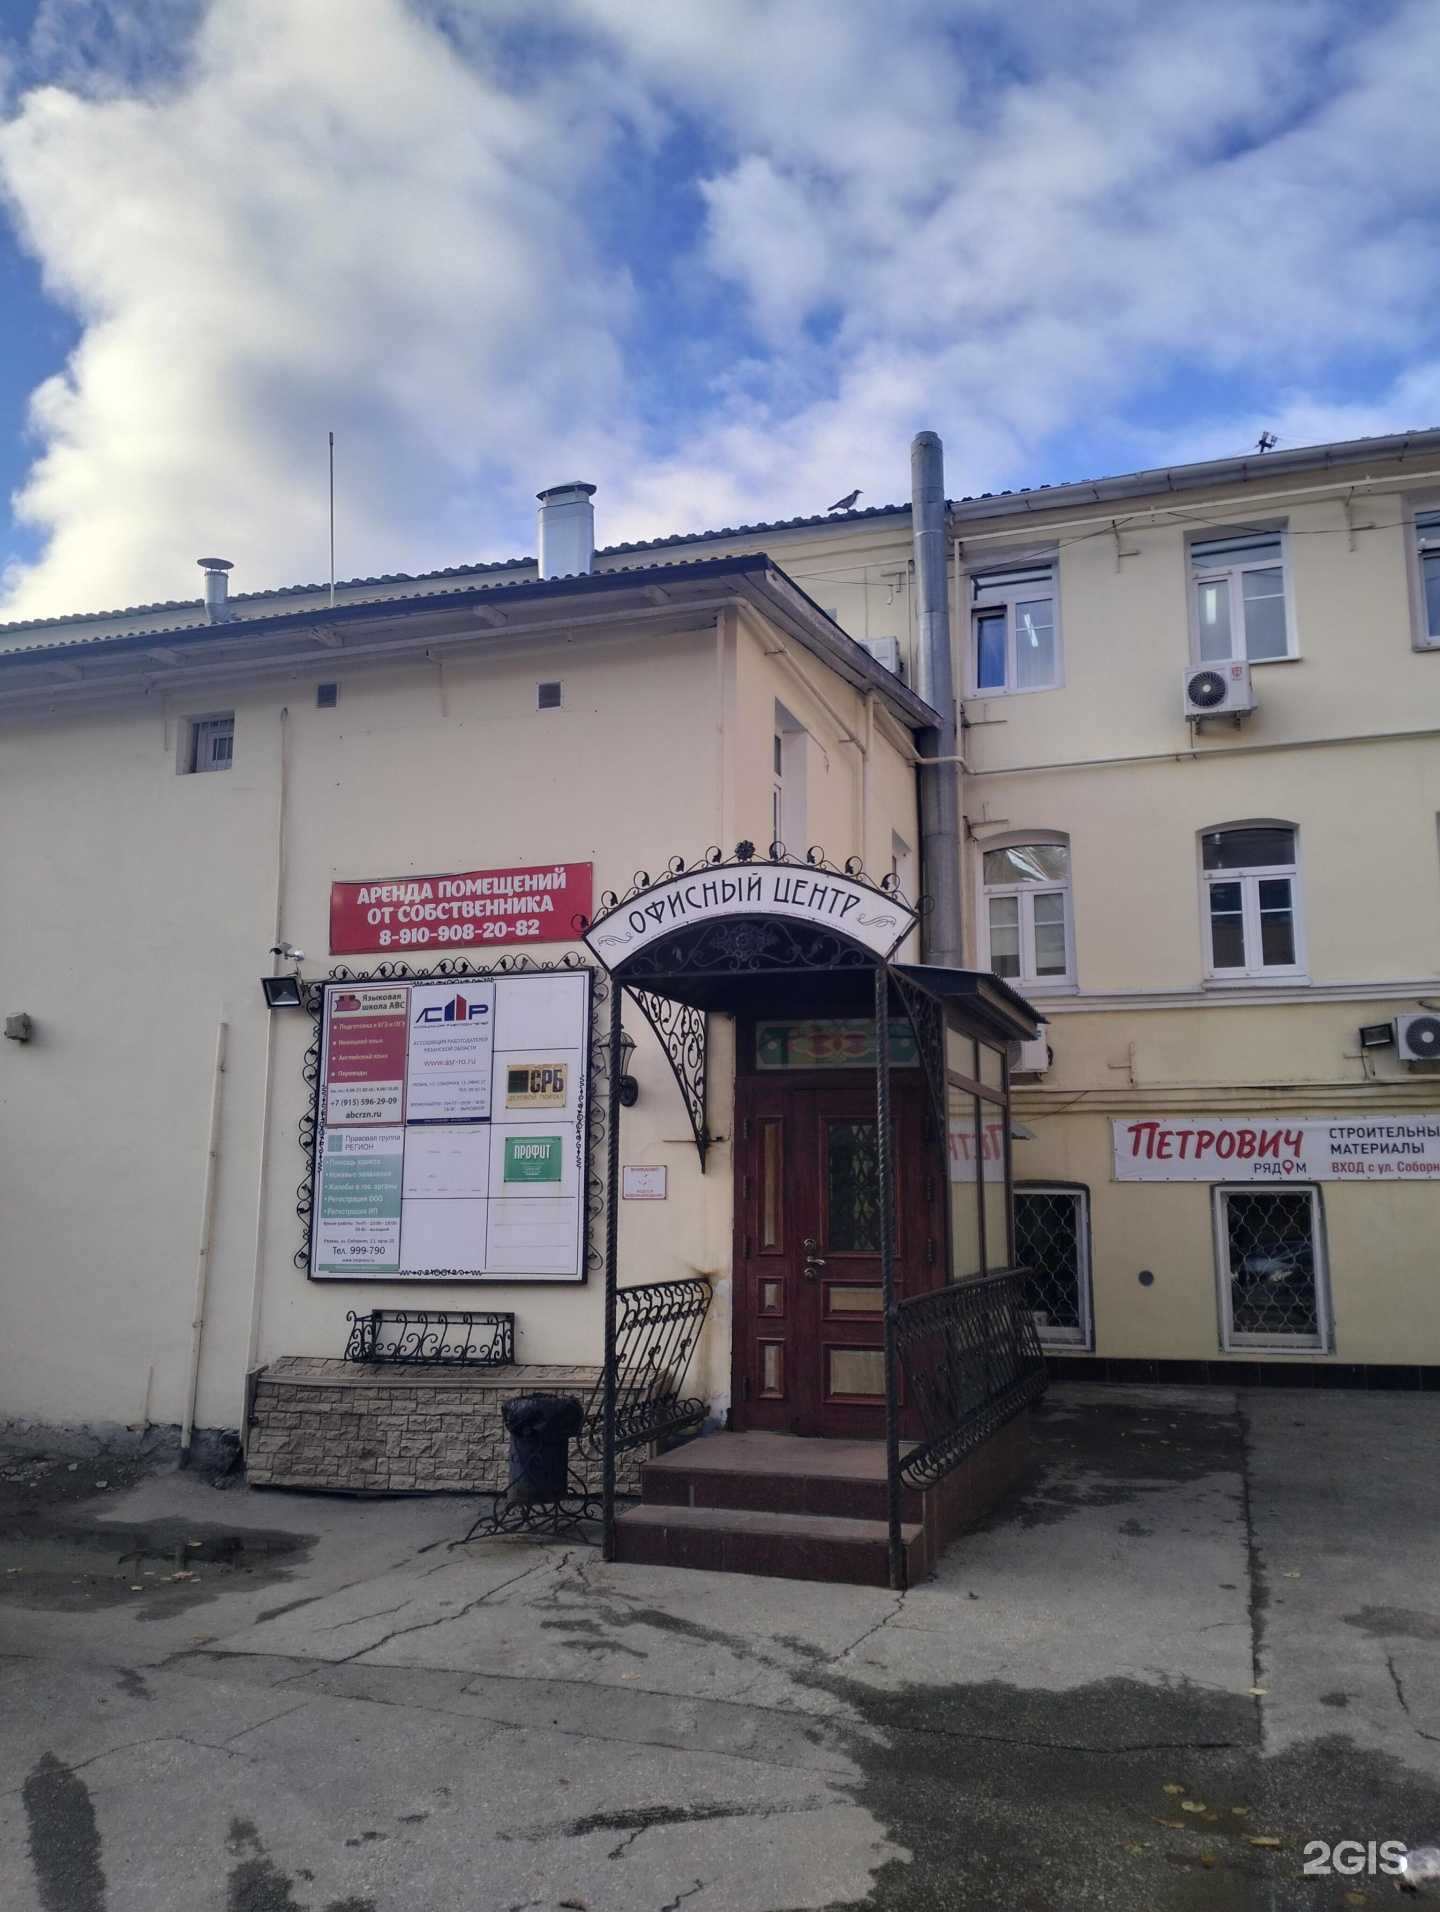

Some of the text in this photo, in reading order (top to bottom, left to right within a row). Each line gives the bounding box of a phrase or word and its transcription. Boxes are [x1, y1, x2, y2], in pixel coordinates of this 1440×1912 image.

[357, 867, 567, 905] АРЕНДА ПОМЕЩЕНИЙ
[367, 895, 554, 925] ОТ СОБСТВЕННИКА
[628, 872, 861, 934] ОФИСНЫЙ ЦЕНТР
[379, 919, 540, 946] 8-910-908-20-82
[362, 1002, 388, 1010] школа
[530, 1069, 564, 1093] СРБ
[330, 1097, 397, 1107] +7 (915) 596-29-09
[345, 1110, 382, 1119] abcrzn.ru
[345, 1134, 400, 1143] Правовая группа
[1329, 1125, 1440, 1139] СТРОИТЕЛЬНЫ
[345, 1143, 374, 1151] РЕГИОН
[1128, 1121, 1304, 1160] ПЕТРОВИЧ
[514, 1144, 551, 1160] ПРОФИТ
[1330, 1142, 1425, 1155] МАТЕРИАЛЫ
[1332, 1161, 1365, 1174] ВХОД
[1368, 1164, 1375, 1173] с
[1377, 1163, 1394, 1176] ул.
[332, 1246, 385, 1255] Тел. 999-790
